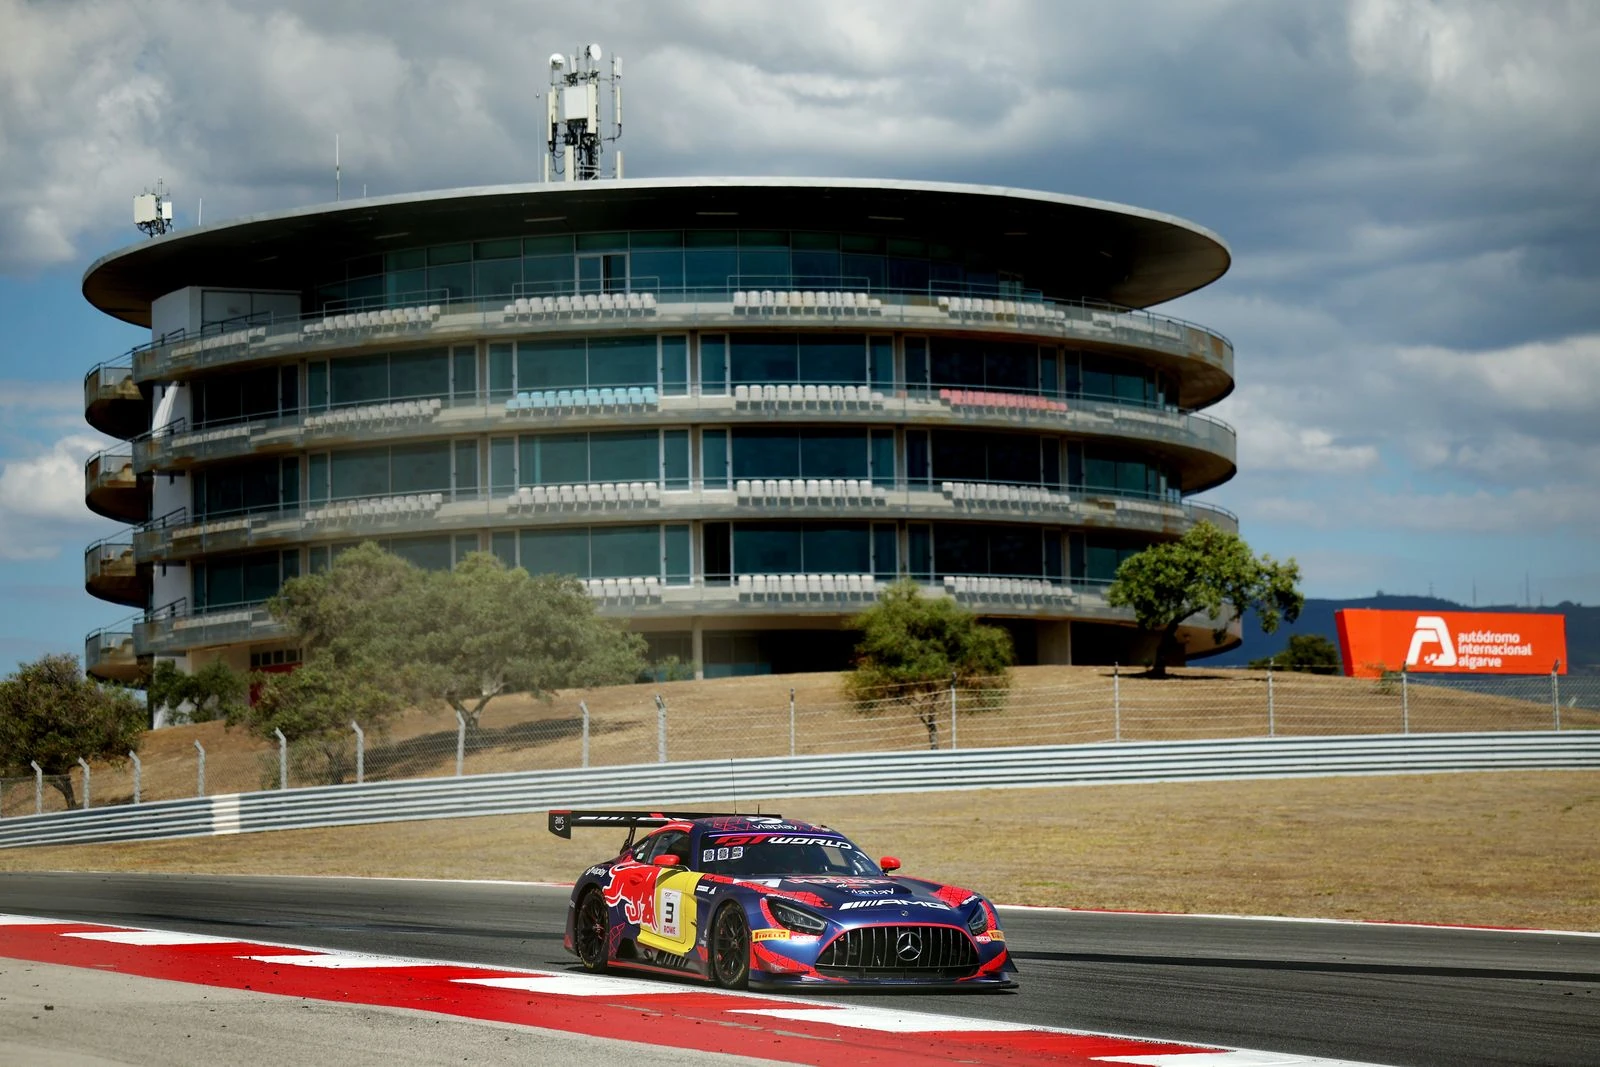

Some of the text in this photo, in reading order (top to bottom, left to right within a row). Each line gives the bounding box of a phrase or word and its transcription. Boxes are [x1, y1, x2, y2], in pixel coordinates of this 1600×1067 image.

[1457, 631, 1520, 643] autódromo
[1457, 643, 1532, 656] internacional
[1457, 655, 1502, 669] algarve
[554, 815, 565, 825] aws
[714, 835, 852, 849] GT WORLD
[874, 899, 951, 911] AMG
[665, 902, 674, 924] 3
[755, 930, 787, 940] PIRELLI
